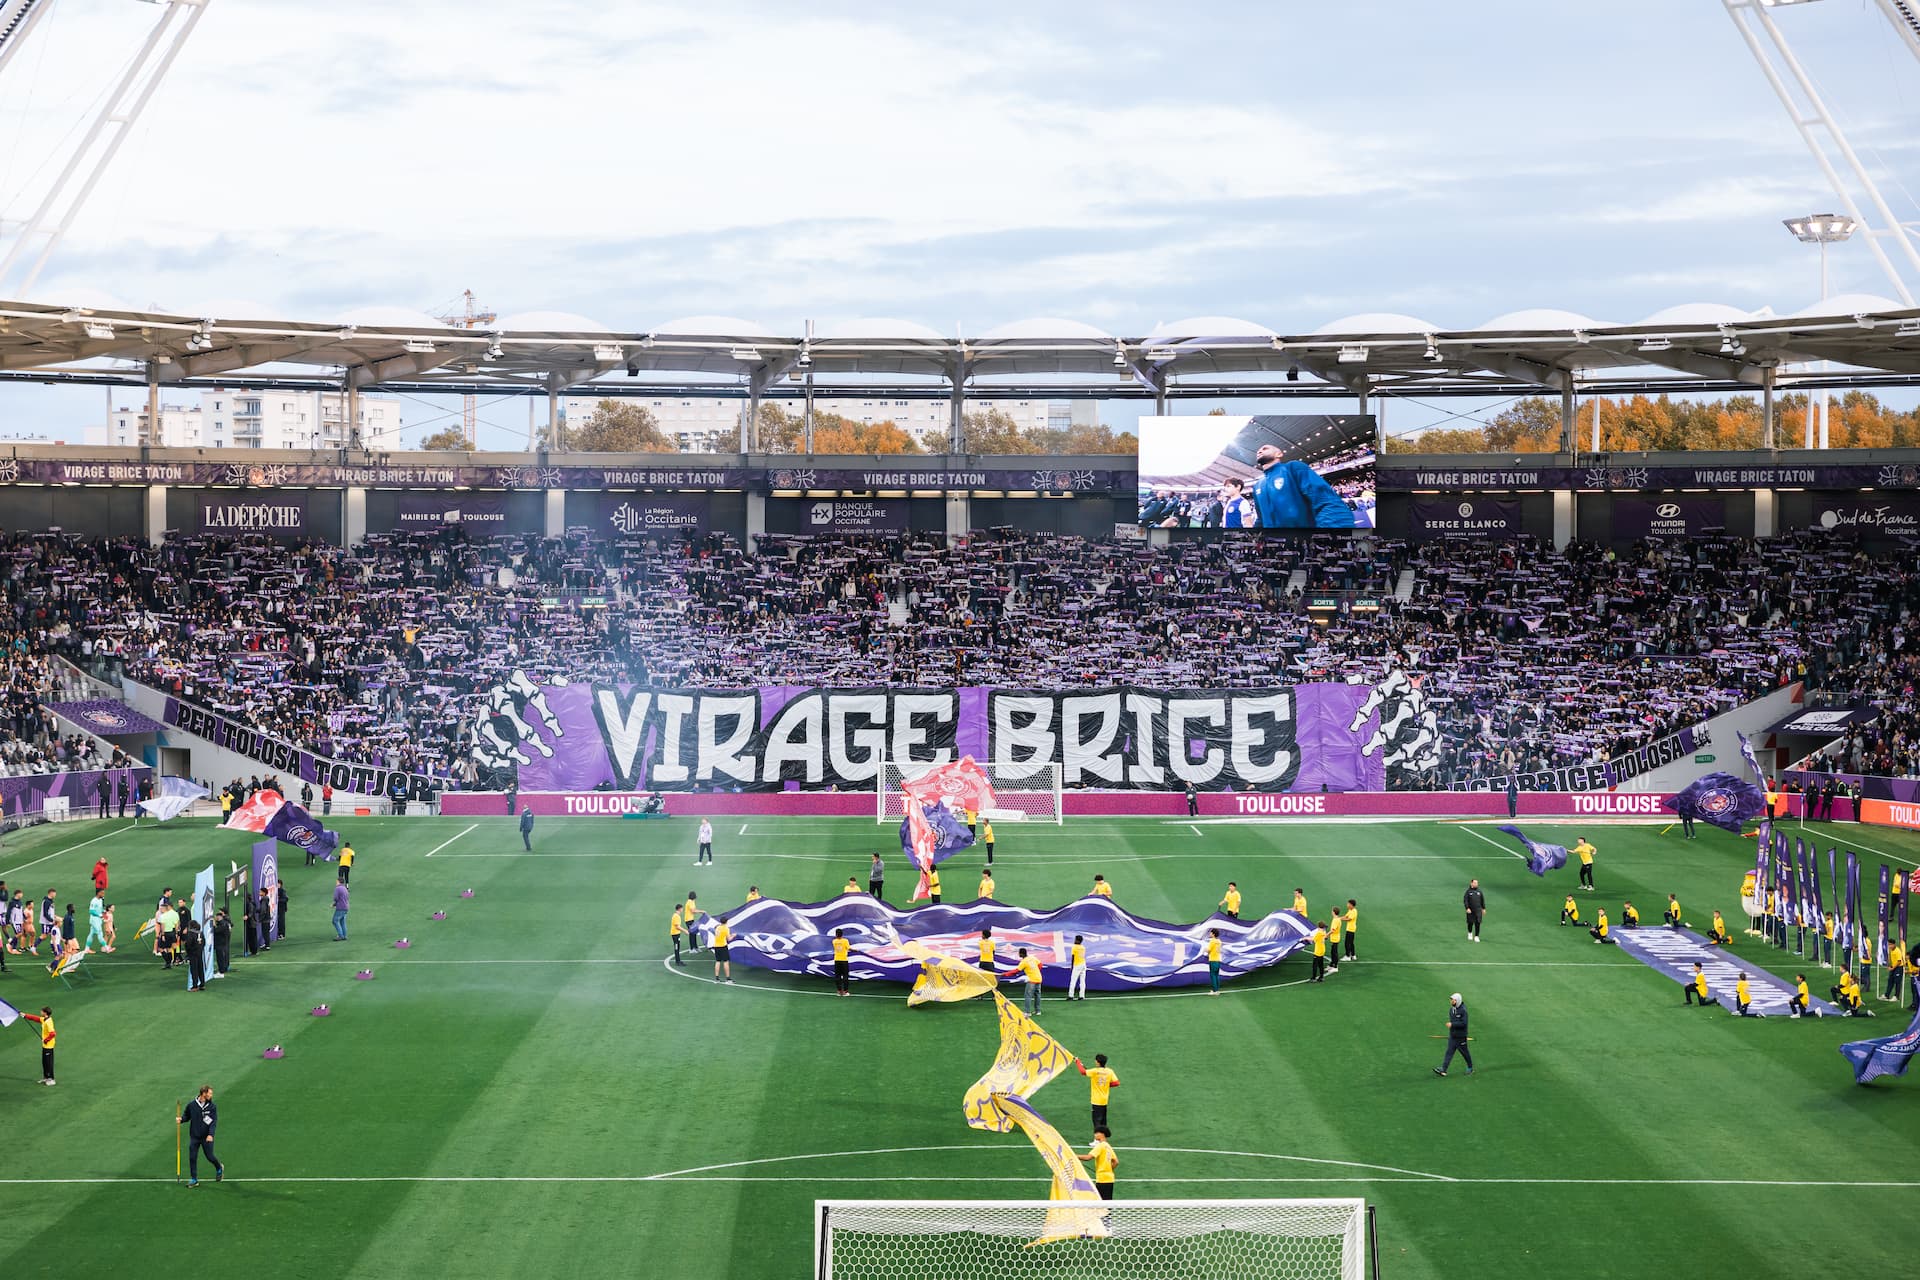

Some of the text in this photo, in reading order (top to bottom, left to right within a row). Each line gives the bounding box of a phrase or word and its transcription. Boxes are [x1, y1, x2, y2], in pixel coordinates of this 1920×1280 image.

[63, 465, 182, 480] VIRAGE BRICE TATON
[333, 469, 454, 483] VIRAGE BRICE TATON
[603, 471, 725, 484] VIRAGE BRICE TATON
[863, 473, 986, 485] VIRAGE BRICE TATON
[1416, 472, 1538, 485] VIRAGE BRICE TATON
[1694, 470, 1815, 483] VIRAGE BRICE TATON
[652, 507, 674, 515] Région
[835, 502, 873, 510] BANQUE
[204, 503, 301, 527] LA DÉPÊCHE
[400, 512, 505, 521] MAIRIE DE TOULOUSE
[645, 513, 698, 524] Occitanie
[1835, 505, 1918, 526] Sud de France
[1425, 519, 1507, 529] SERGE BLANCO
[176, 703, 218, 746] PER
[223, 722, 301, 777] TOLOSA
[597, 690, 1291, 784] VIRAGE BRICE
[1610, 734, 1685, 784] TOLOSA
[564, 796, 648, 813] TOULOU
[1236, 796, 1325, 813] TOULOUSE
[1572, 795, 1661, 813] TOULOUSE
